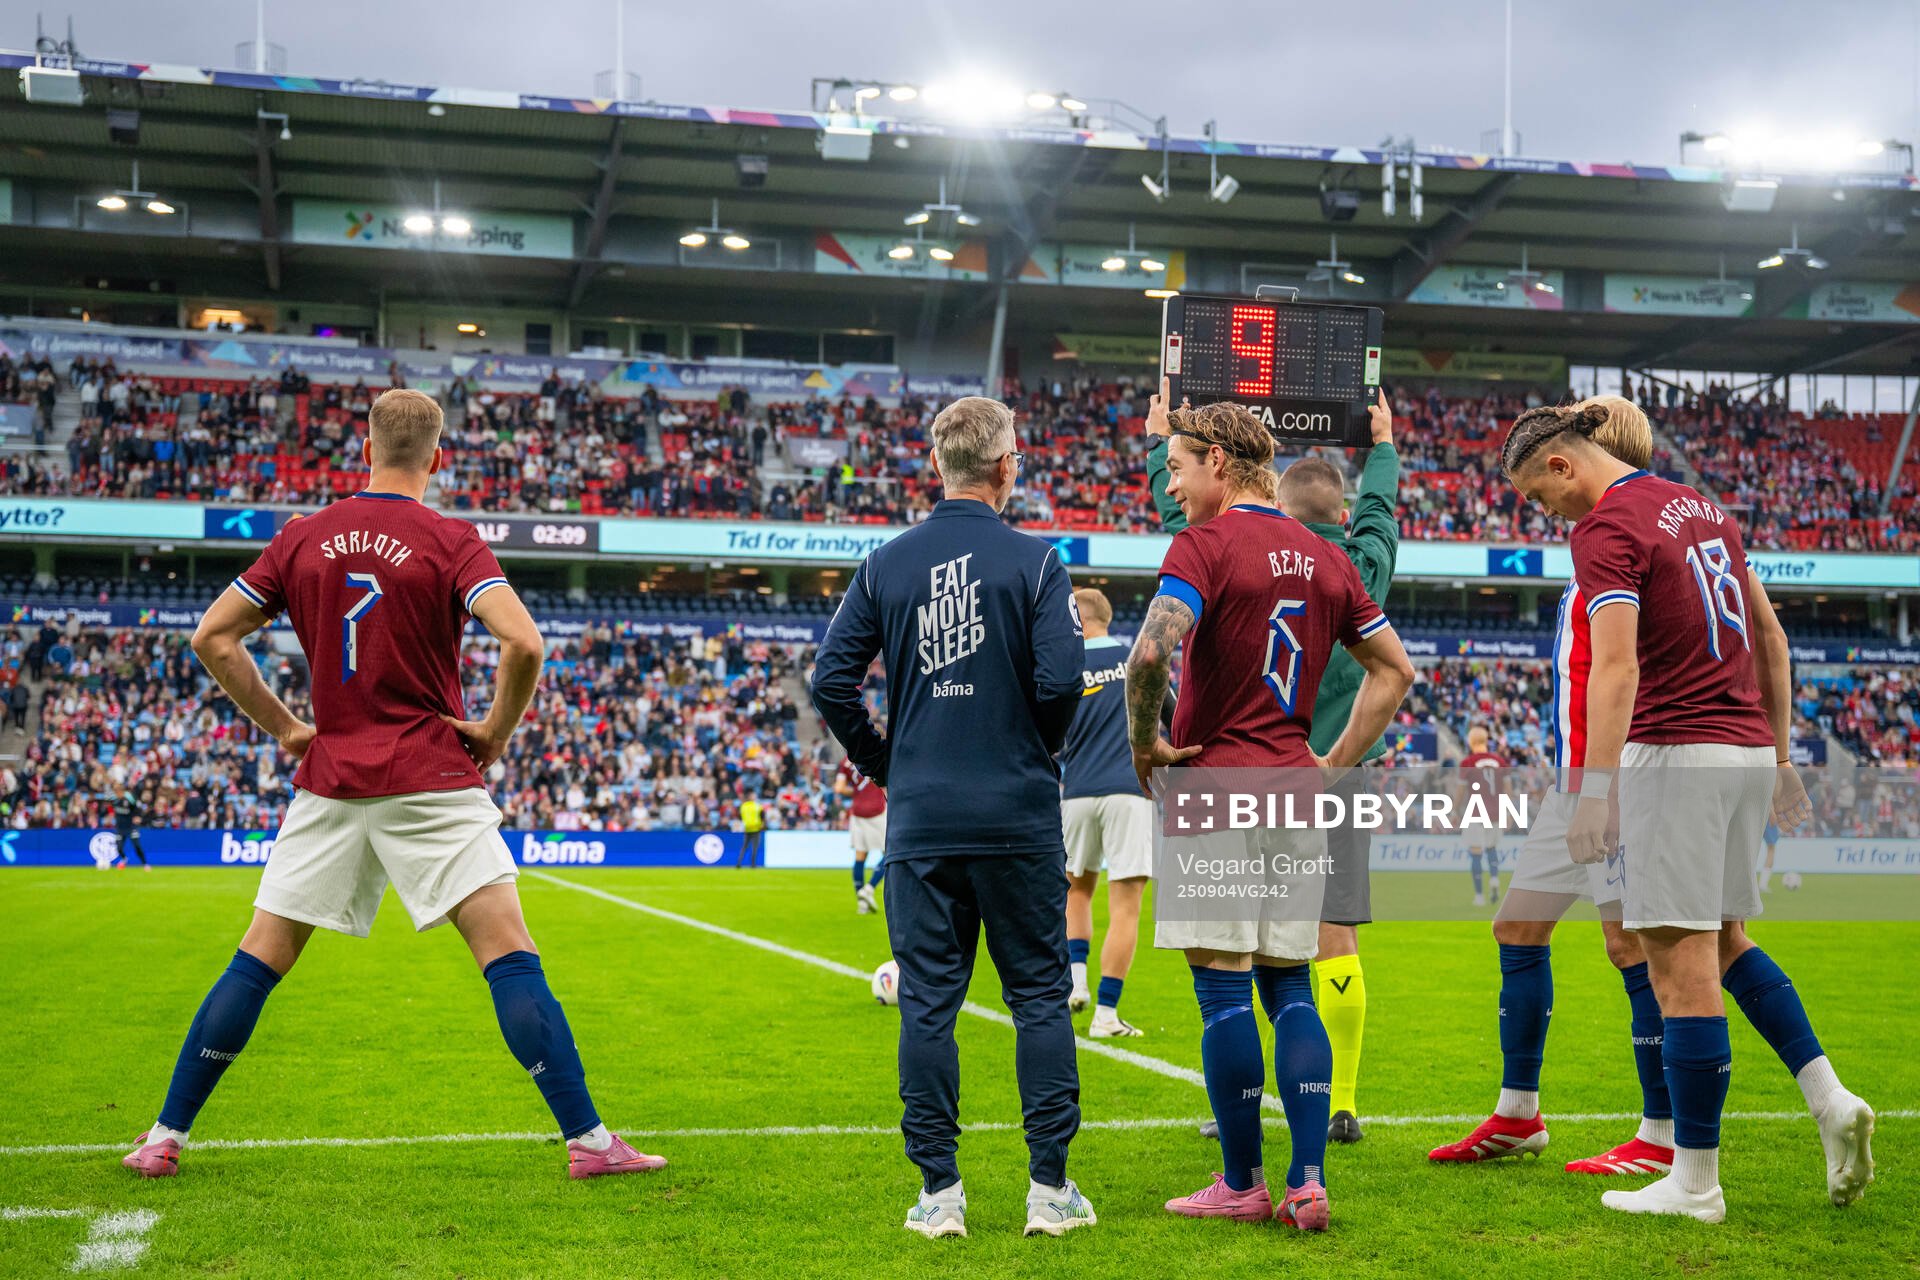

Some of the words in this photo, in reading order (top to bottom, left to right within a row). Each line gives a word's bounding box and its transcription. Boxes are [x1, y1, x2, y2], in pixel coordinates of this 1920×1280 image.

[1232, 306, 1276, 396] 9
[1235, 405, 1331, 431] FA.com
[533, 525, 586, 544] 02:09
[728, 531, 760, 548] Tid
[767, 533, 798, 549] for
[930, 552, 973, 600] EAT
[1268, 549, 1315, 582] BERG
[917, 579, 983, 642] MOVE
[1686, 537, 1750, 661] 18
[341, 572, 384, 685] 7
[918, 623, 986, 676] SLEEP
[1262, 599, 1307, 718] 6
[1082, 662, 1128, 688] Bend
[522, 833, 605, 864] bama
[1381, 844, 1410, 860] Tid
[1417, 844, 1445, 860] for
